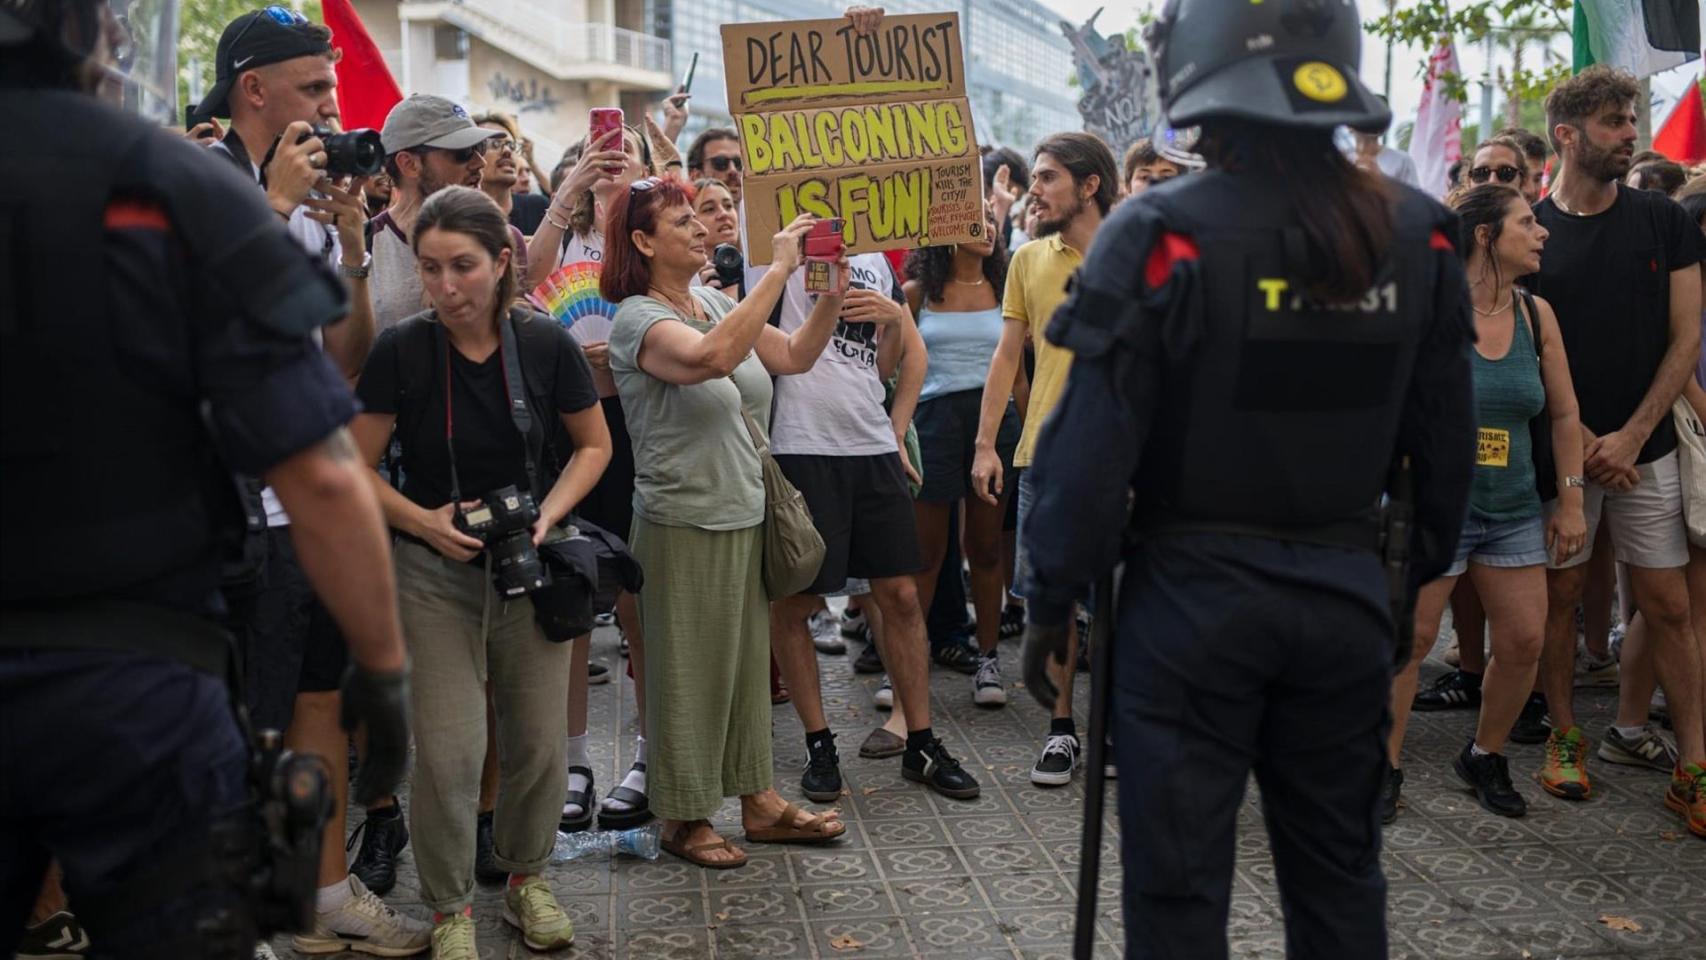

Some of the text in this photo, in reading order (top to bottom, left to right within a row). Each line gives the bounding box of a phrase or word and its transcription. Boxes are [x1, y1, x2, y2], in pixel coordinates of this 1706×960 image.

[747, 21, 953, 86] DEAR TOURIST
[741, 102, 969, 174] BALCONING
[936, 164, 971, 179] TOURISM
[959, 177, 973, 187] THE
[941, 189, 967, 202] CITY!!
[776, 167, 933, 247] IS FUN!
[965, 201, 975, 210] GO
[583, 245, 602, 261] TO
[851, 266, 876, 284] MO
